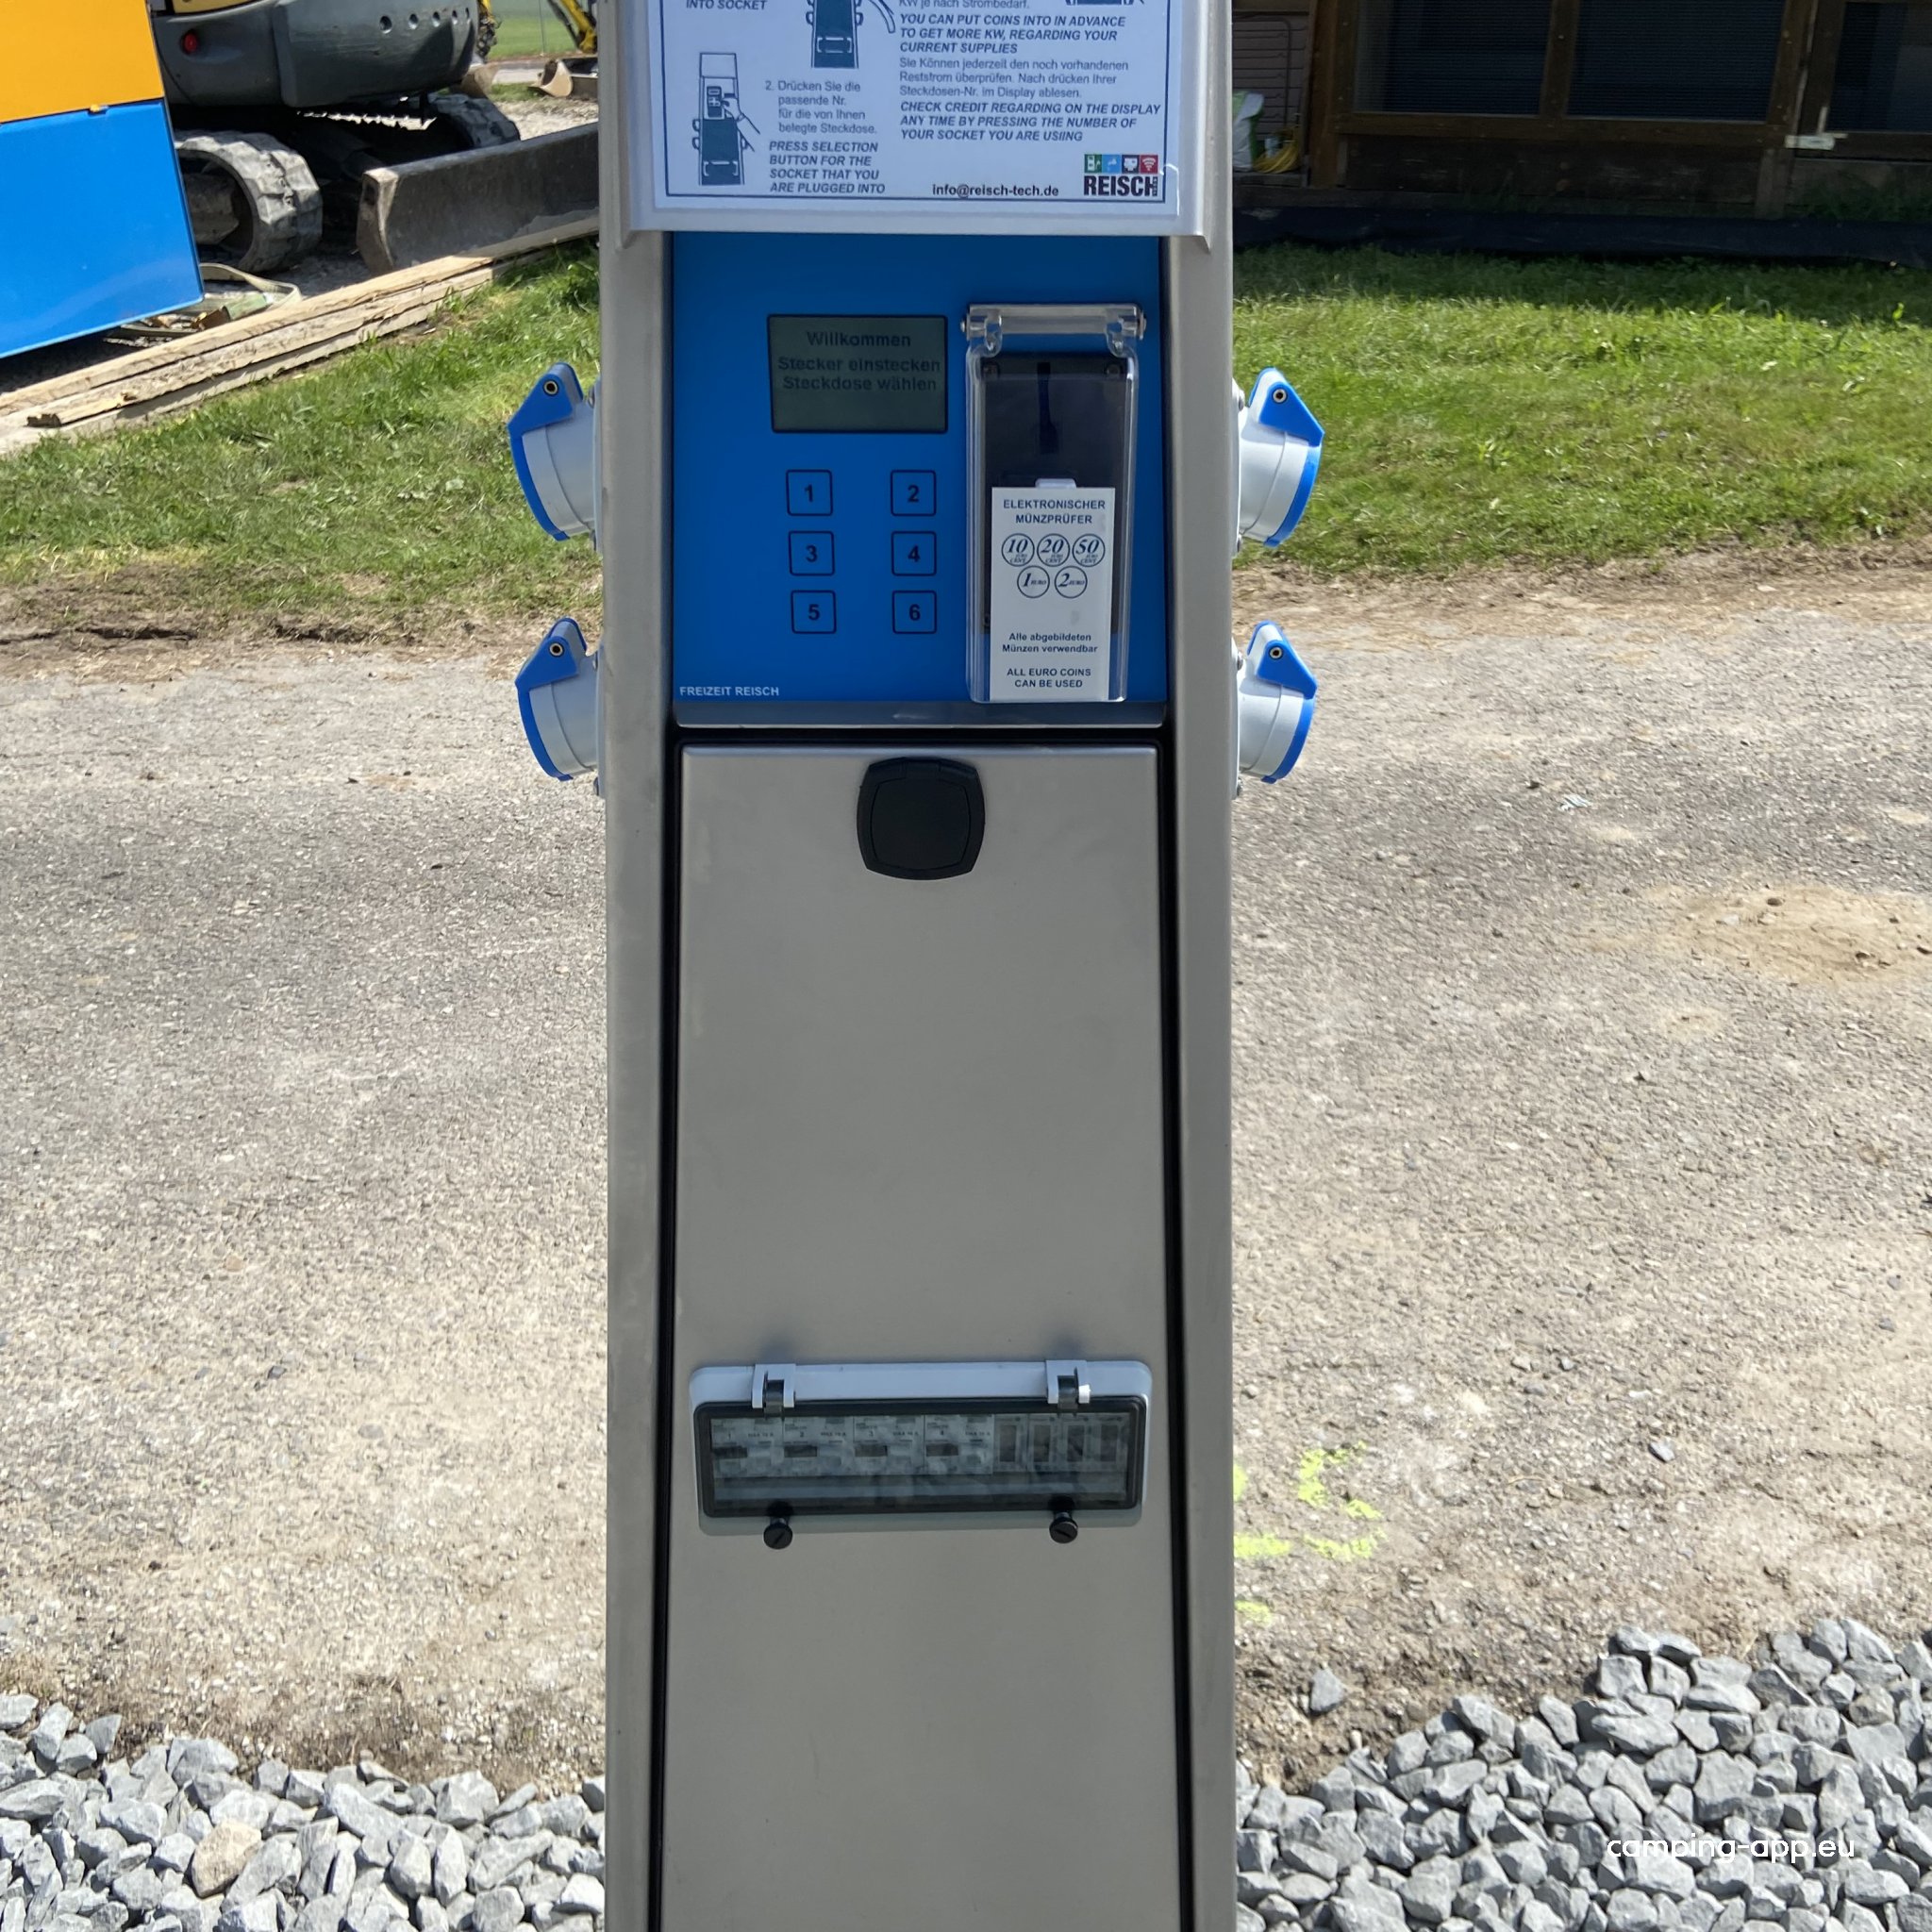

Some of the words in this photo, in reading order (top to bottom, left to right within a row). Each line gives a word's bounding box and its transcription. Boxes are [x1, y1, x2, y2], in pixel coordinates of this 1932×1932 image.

[686, 0, 714, 9] INTO
[717, 0, 767, 10] SOCKET
[900, 13, 925, 25] YOU
[928, 14, 954, 25] CAN
[958, 14, 981, 25] PUT
[984, 15, 1021, 25] COINS
[1024, 15, 1052, 26] INTO
[1054, 16, 1067, 26] IN
[1069, 16, 1126, 27] ADVANCE
[901, 28, 916, 39] TO
[920, 28, 942, 39] GET
[946, 29, 981, 40] MORE
[985, 29, 1006, 42] KW,
[1009, 30, 1080, 41] REGARDING
[1085, 30, 1118, 41] YOUR
[900, 42, 958, 53] CURRENT
[960, 43, 1018, 54] SUPPLIES
[899, 58, 917, 68] Sie
[962, 58, 1007, 71] jederzeit
[1009, 59, 1029, 69] den
[1033, 59, 1058, 70] noch
[1060, 60, 1128, 71] vorhandenen
[900, 71, 952, 82] Reststrom
[1019, 73, 1045, 83] Nach
[1048, 74, 1090, 84] drücken
[1092, 74, 1117, 84] Ihrer
[777, 80, 822, 92] Drücken
[824, 81, 842, 92] Sie
[844, 81, 861, 92] die
[982, 87, 994, 97] im
[997, 87, 1036, 100] Display
[778, 95, 829, 108] passende
[900, 102, 941, 112] CHECK
[945, 102, 989, 112] CREDIT
[991, 103, 1061, 113] REGARDING
[1064, 104, 1082, 113] ON
[1086, 104, 1108, 114] THE
[1111, 104, 1160, 114] DISPLAY
[778, 108, 791, 119] für
[794, 108, 811, 119] die
[814, 110, 833, 119] von
[836, 109, 866, 120] Ihnen
[900, 115, 924, 125] ANY
[928, 116, 956, 126] TIME
[958, 116, 975, 126] BY
[977, 116, 1038, 127] PRESSING
[1041, 117, 1063, 127] THE
[1066, 117, 1117, 127] NUMBER
[1120, 118, 1137, 128] OF
[778, 122, 817, 135] belegte
[820, 123, 877, 134] Steckdose.
[901, 129, 934, 140] YOUR
[937, 130, 986, 141] SOCKET
[989, 130, 1013, 141] YOU
[1015, 130, 1040, 141] ARE
[769, 141, 808, 152] PRESS
[811, 142, 878, 152] SELECTION
[769, 155, 818, 165] BUTTON
[820, 156, 845, 166] FOR
[849, 156, 872, 166] THE
[769, 169, 819, 179] SOCKET
[822, 169, 851, 179] THAT
[855, 170, 879, 180] YOU
[770, 182, 795, 192] ARE
[797, 183, 855, 193] PLUGGED
[858, 184, 886, 194] INTO
[932, 184, 1059, 198] info@reisch-tech.de
[1084, 175, 1158, 196] REISCH
[807, 331, 911, 347] Willkommen
[777, 356, 843, 371] Stecker
[848, 358, 941, 373] einstecken
[783, 375, 873, 391] Steckdose
[877, 376, 938, 391] wählen
[805, 484, 814, 503] 1
[908, 484, 920, 503] 2
[1003, 499, 1106, 509] ELEKTRONISCHER
[1016, 513, 1092, 525] MÜNZPRÜFER
[1007, 539, 1028, 554] 10
[1041, 539, 1064, 554] 20
[1075, 539, 1099, 555] 50
[806, 545, 817, 563] 3
[908, 545, 921, 563] 4
[1023, 573, 1032, 587] 1
[1058, 573, 1070, 587] 2
[808, 604, 819, 621] 5
[908, 604, 921, 621] 6
[1009, 633, 1027, 641] Alle
[1030, 633, 1091, 644] abgebildeten
[1002, 644, 1039, 653] Münzen
[1041, 644, 1098, 653] verwendbar
[679, 686, 731, 696] FREIZEIT
[735, 686, 779, 696] REISCH
